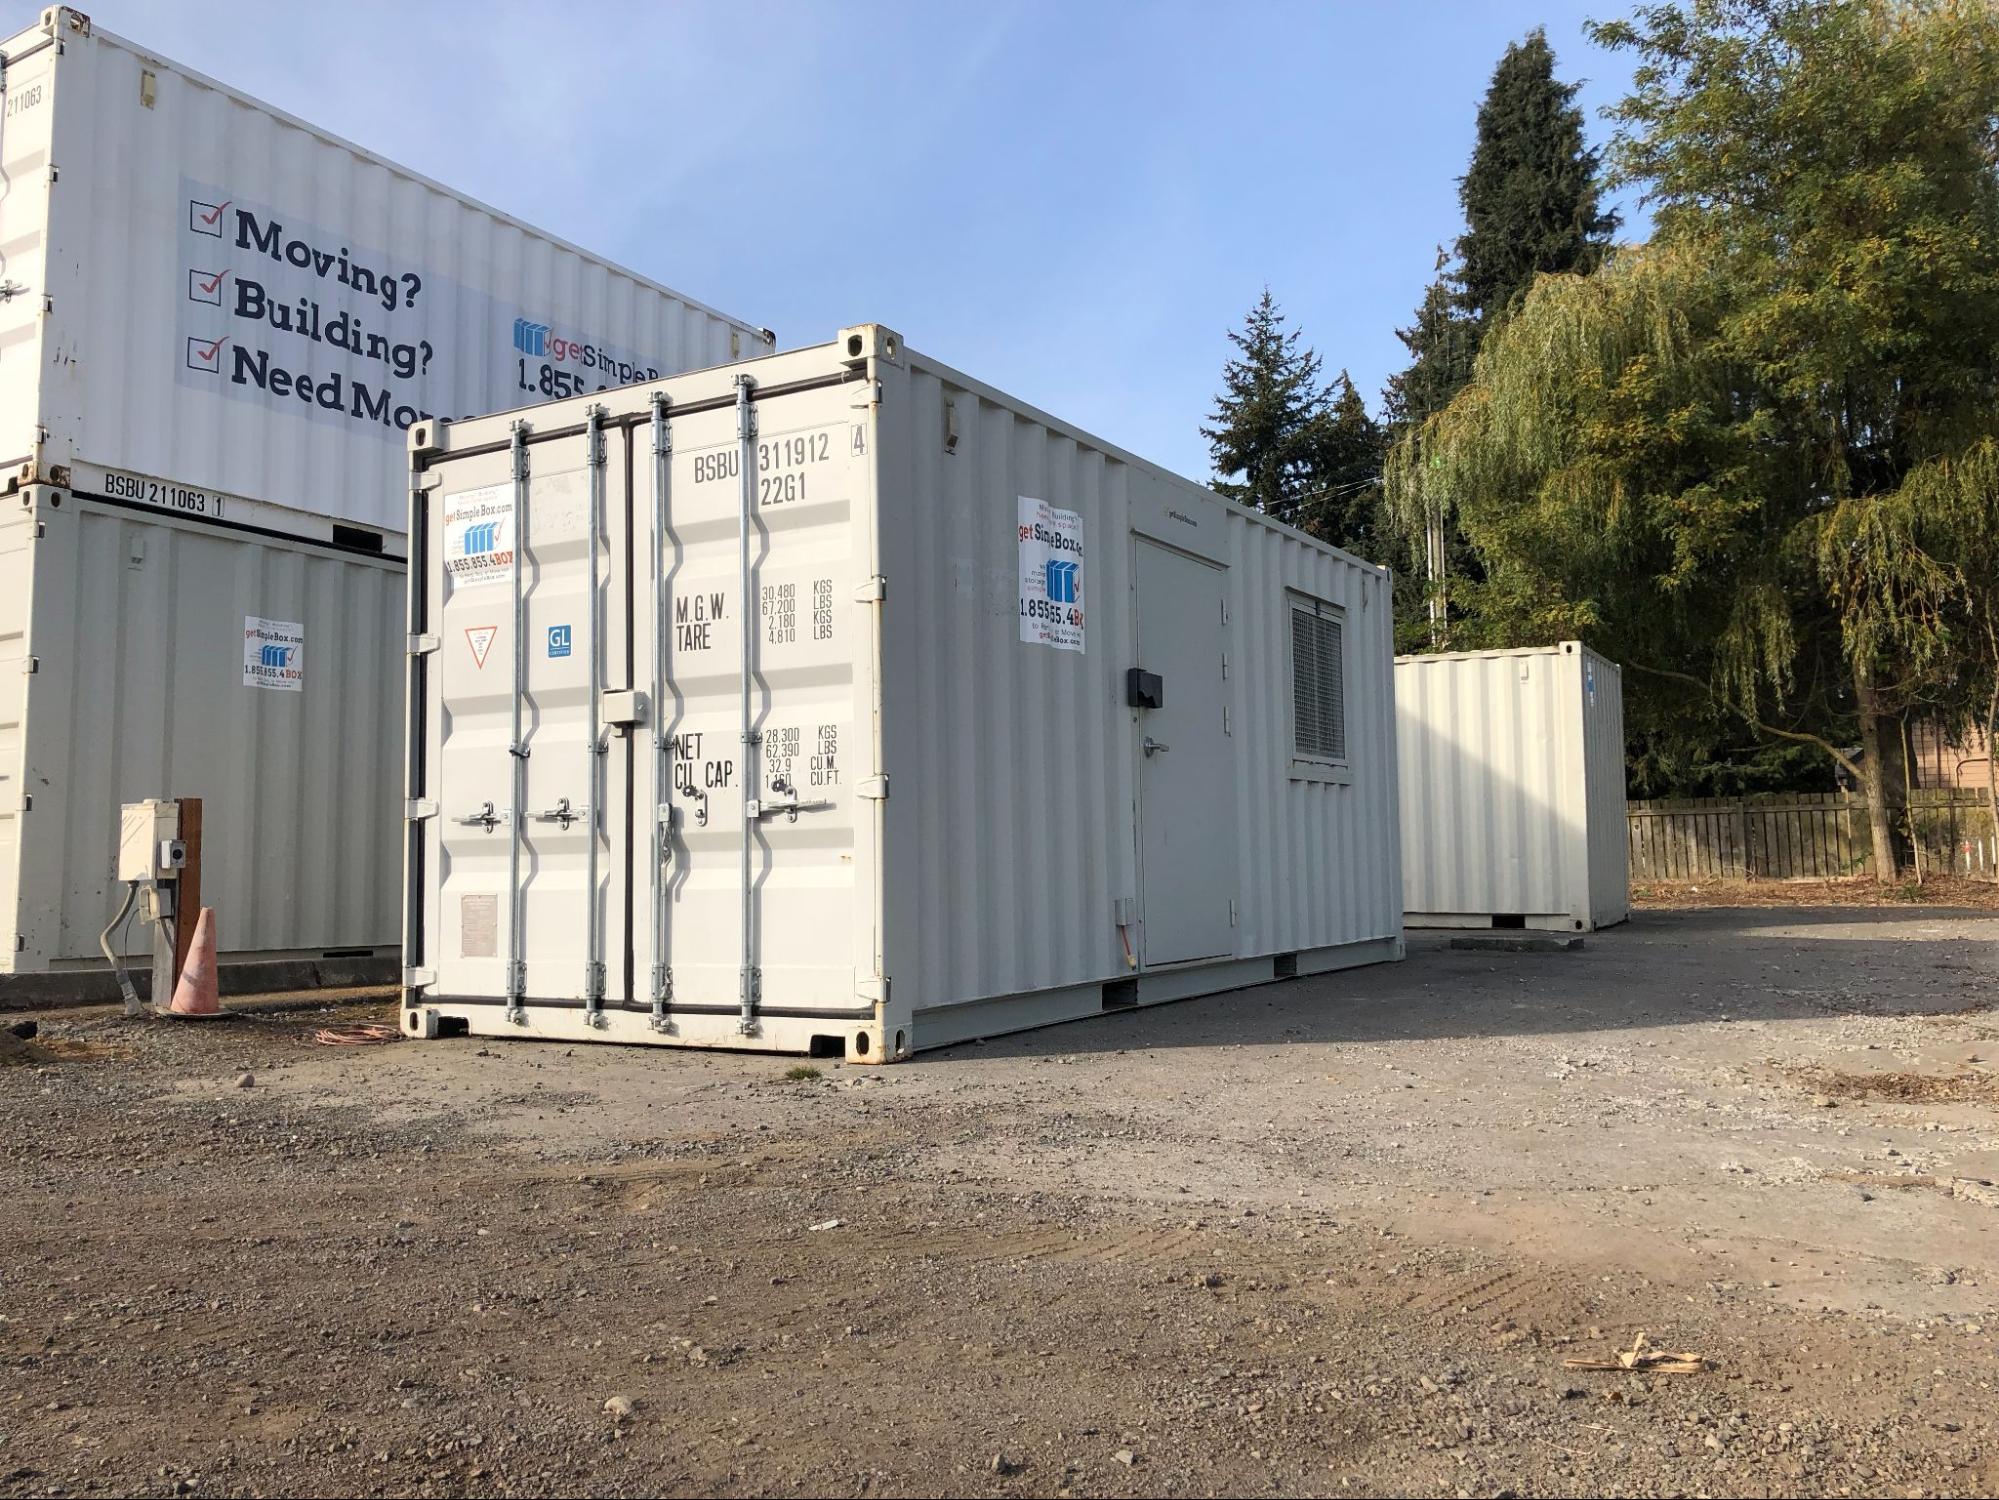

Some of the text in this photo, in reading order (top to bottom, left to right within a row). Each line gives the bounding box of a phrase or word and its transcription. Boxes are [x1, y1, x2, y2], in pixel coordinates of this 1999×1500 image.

[7, 85, 42, 118] 211063
[235, 208, 422, 312] Moving?
[234, 277, 434, 379] Building?
[231, 344, 345, 412] Need
[694, 425, 866, 484] BSBU 311912 4
[105, 473, 145, 500] BSBU
[149, 483, 205, 512] 211063
[760, 471, 806, 506] 22G1
[676, 579, 833, 624] M.G.W. 30,480 KGS
[762, 594, 833, 616] 67,200 LBS
[549, 628, 570, 647] GL
[676, 622, 711, 652] TARE
[813, 609, 833, 625] KGS
[768, 624, 833, 645] 4,810 LBS
[674, 725, 838, 761] NET 28,300 KGS
[818, 740, 838, 755] LBS
[705, 760, 739, 788] CAP.
[769, 758, 791, 773] 32.9
[810, 756, 838, 771] CU.M.
[810, 771, 842, 786] CU.FT.
